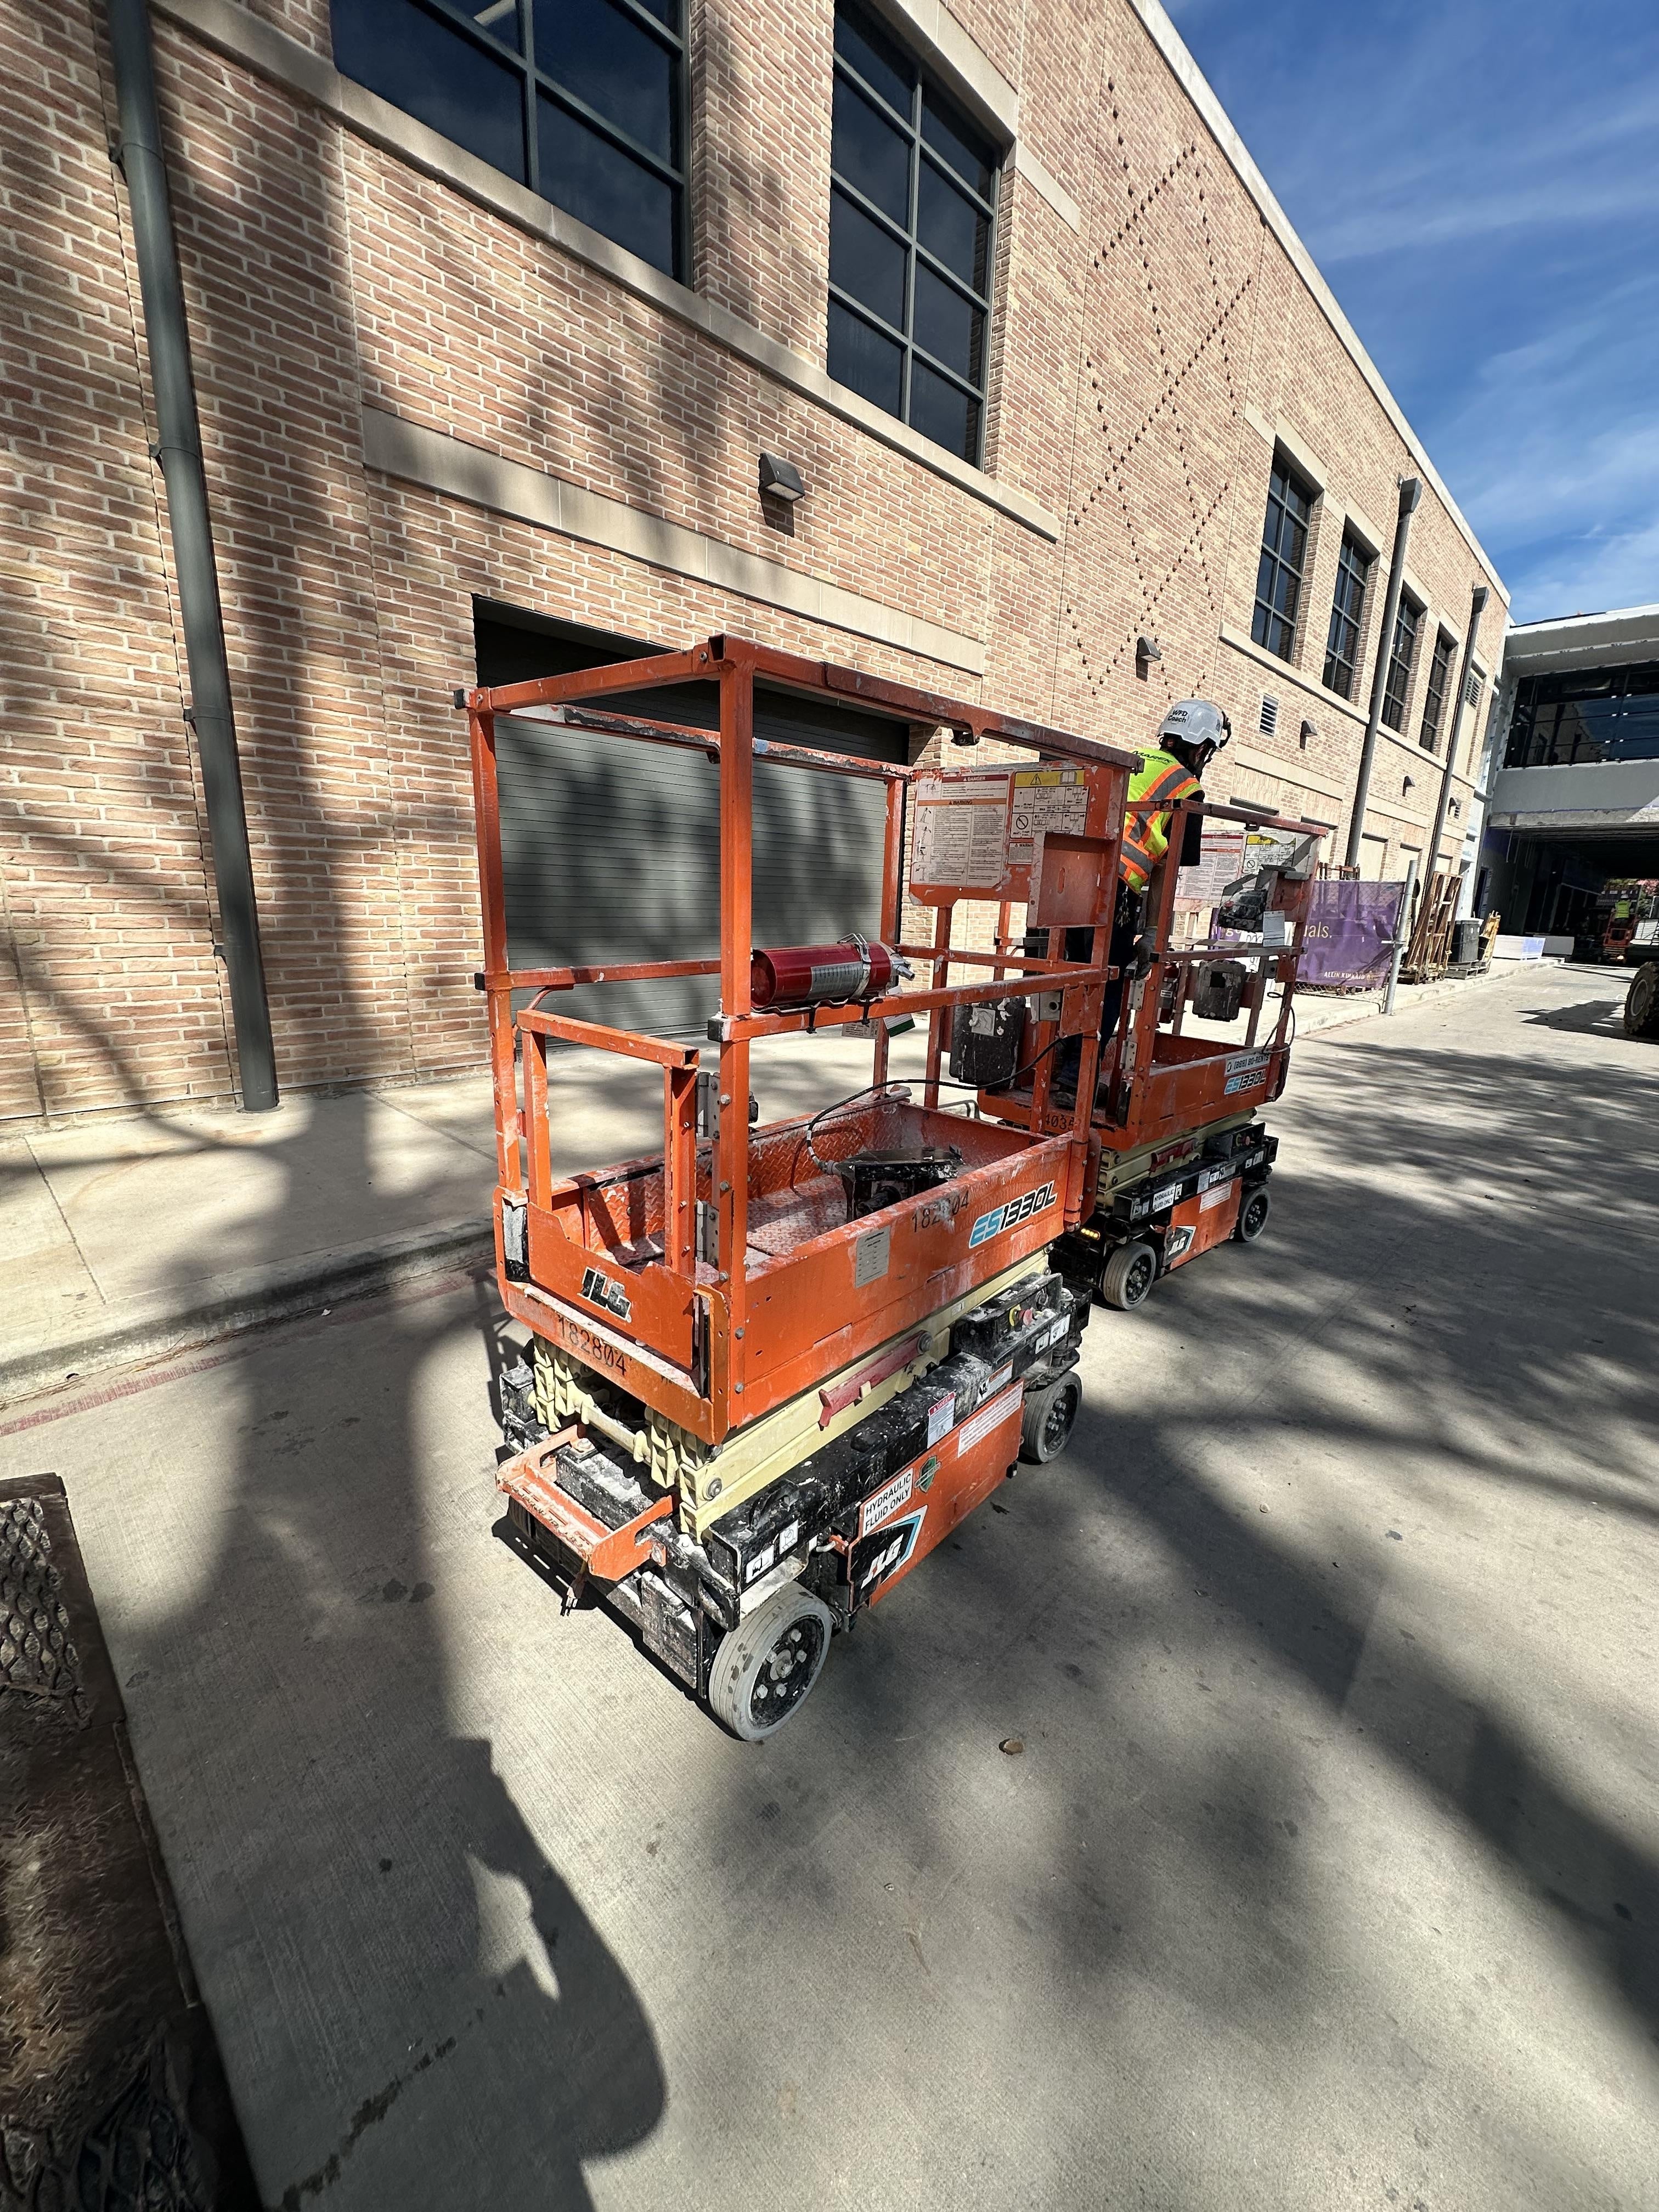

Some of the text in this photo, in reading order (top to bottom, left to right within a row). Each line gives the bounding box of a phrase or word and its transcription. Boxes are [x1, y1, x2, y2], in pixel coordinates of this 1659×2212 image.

[1224, 1069, 1267, 1094] ES1330L
[912, 1189, 969, 1233] 18204
[969, 1180, 1058, 1249] ES1330L
[577, 1266, 631, 1322] JLG
[558, 1316, 627, 1376] 182804
[865, 1486, 910, 1531] FLUID ONLY
[866, 1473, 911, 1517] HYDRAULIC
[861, 1533, 904, 1589] JLG
